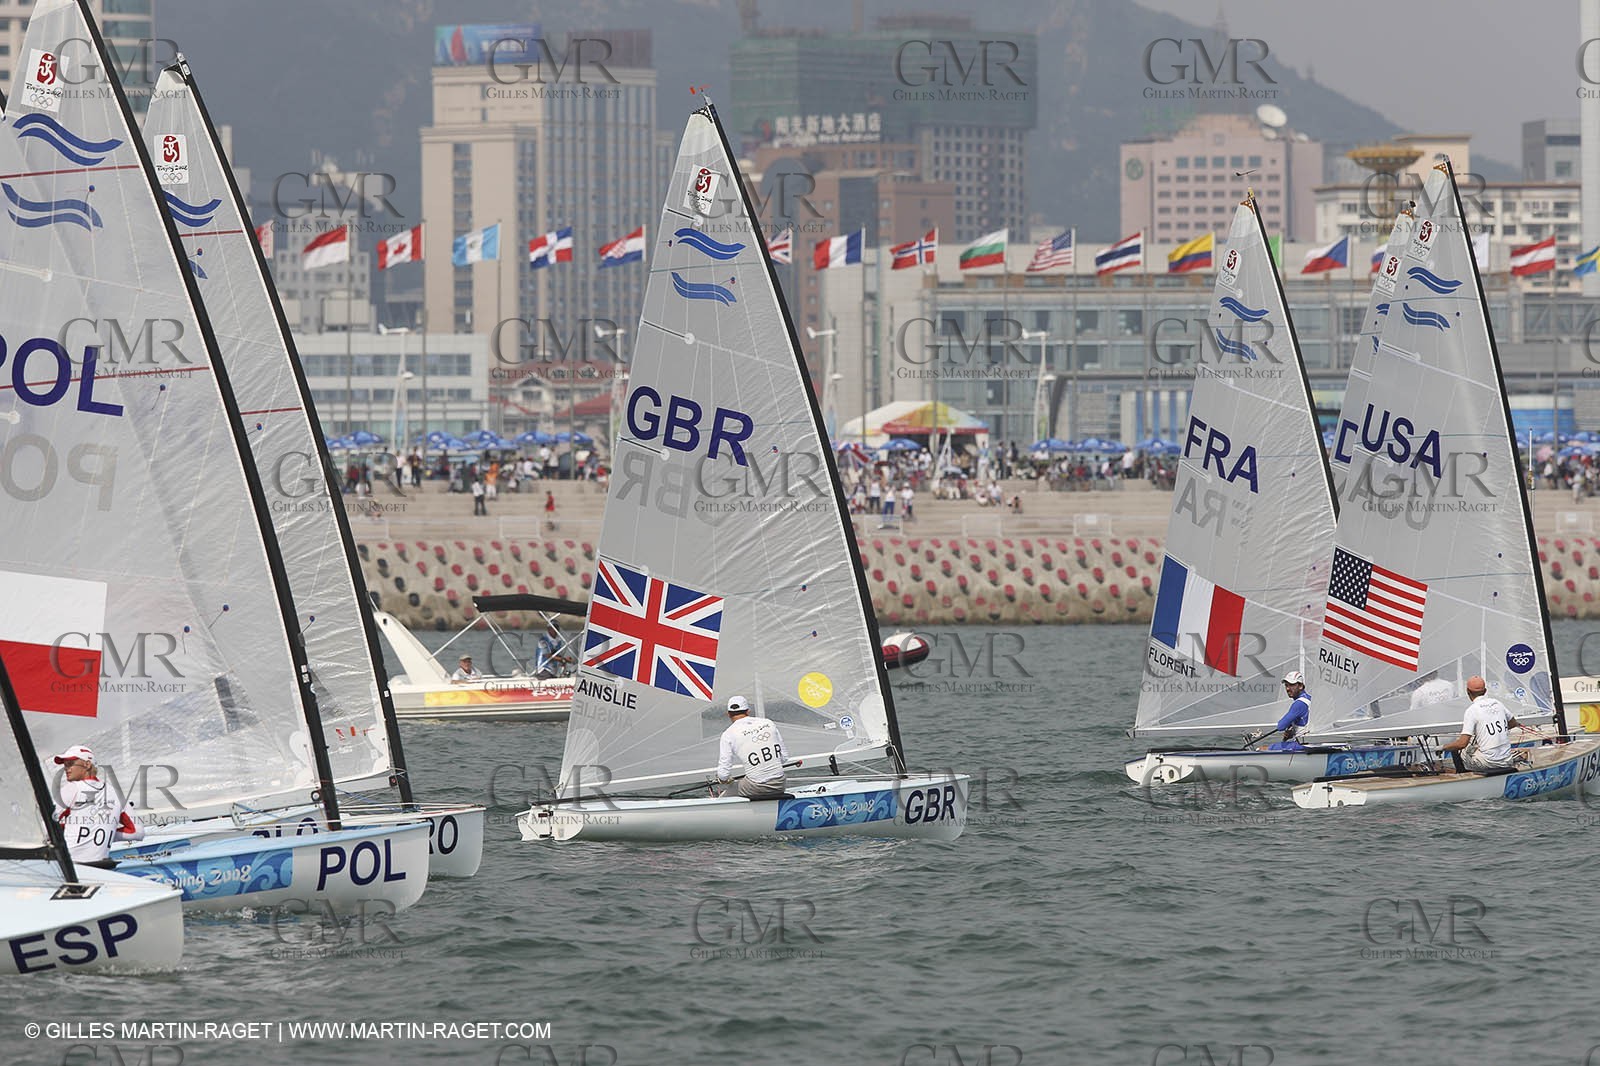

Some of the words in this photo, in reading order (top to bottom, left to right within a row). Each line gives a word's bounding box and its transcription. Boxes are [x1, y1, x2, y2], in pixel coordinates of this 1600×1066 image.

[0, 334, 124, 417] OL
[627, 386, 754, 467] GBR
[1361, 403, 1441, 479] USA
[1184, 415, 1259, 493] FRA
[1148, 647, 1196, 678] FLORENT
[1319, 648, 1360, 674] RAILEY
[577, 679, 637, 709] AINSLIE
[748, 743, 782, 766] GBR
[1399, 750, 1417, 767] FR
[807, 800, 847, 821] Beijing
[848, 799, 875, 815] 2008
[904, 785, 956, 824] GBR
[209, 864, 252, 886] 2008
[317, 838, 406, 891] POL
[9, 913, 138, 974] ESP
